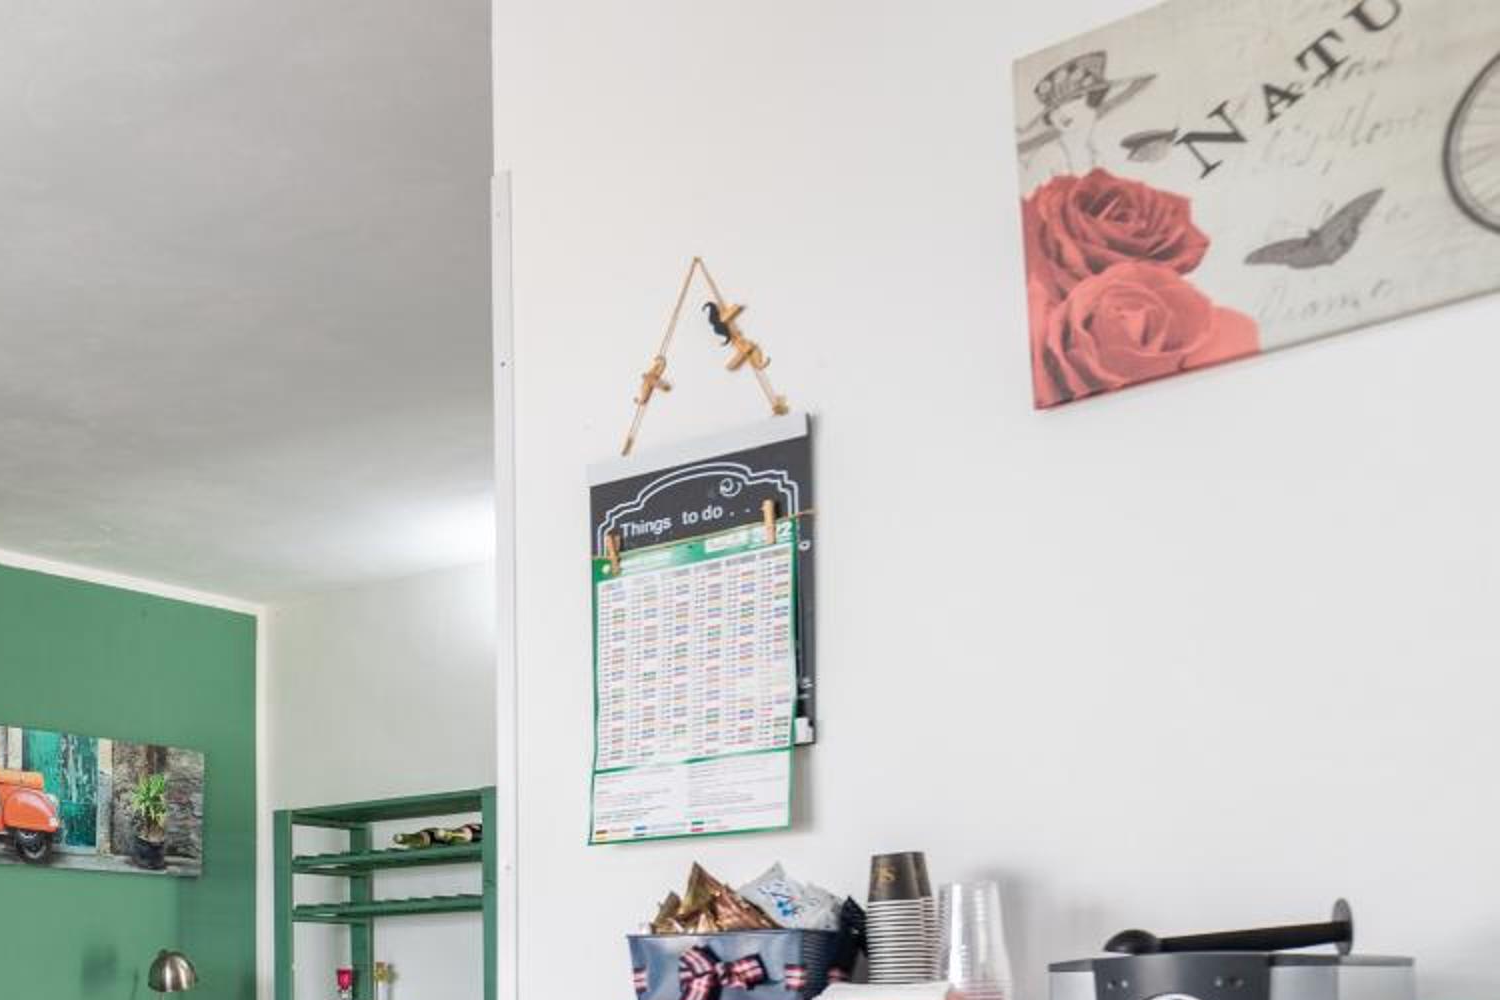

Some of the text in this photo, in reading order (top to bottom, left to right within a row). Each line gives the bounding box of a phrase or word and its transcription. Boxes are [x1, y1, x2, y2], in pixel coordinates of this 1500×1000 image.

[620, 504, 723, 537] Things to do
